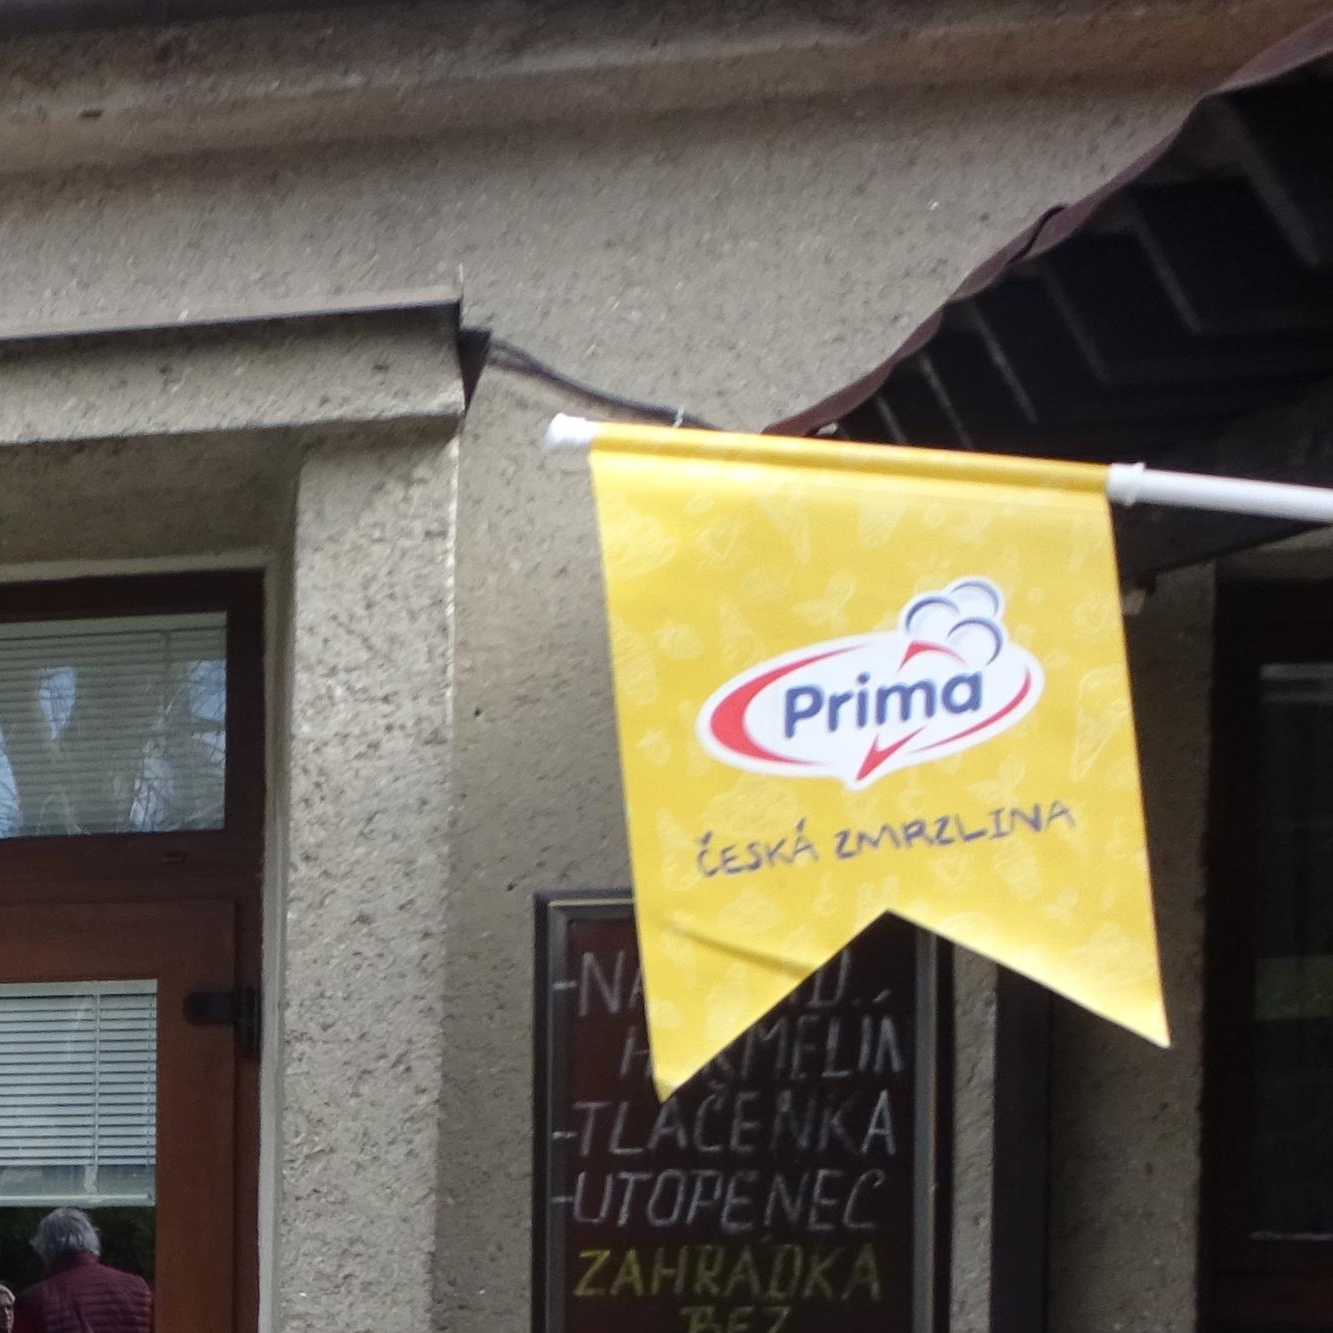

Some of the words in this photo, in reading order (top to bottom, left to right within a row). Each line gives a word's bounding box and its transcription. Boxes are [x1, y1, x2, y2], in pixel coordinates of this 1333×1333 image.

[783, 671, 984, 739] Prima
[695, 816, 820, 877] ČESKÁ
[834, 799, 1076, 859] ZMRZLINA
[574, 1234, 882, 1302] ZAHRÁDKA
